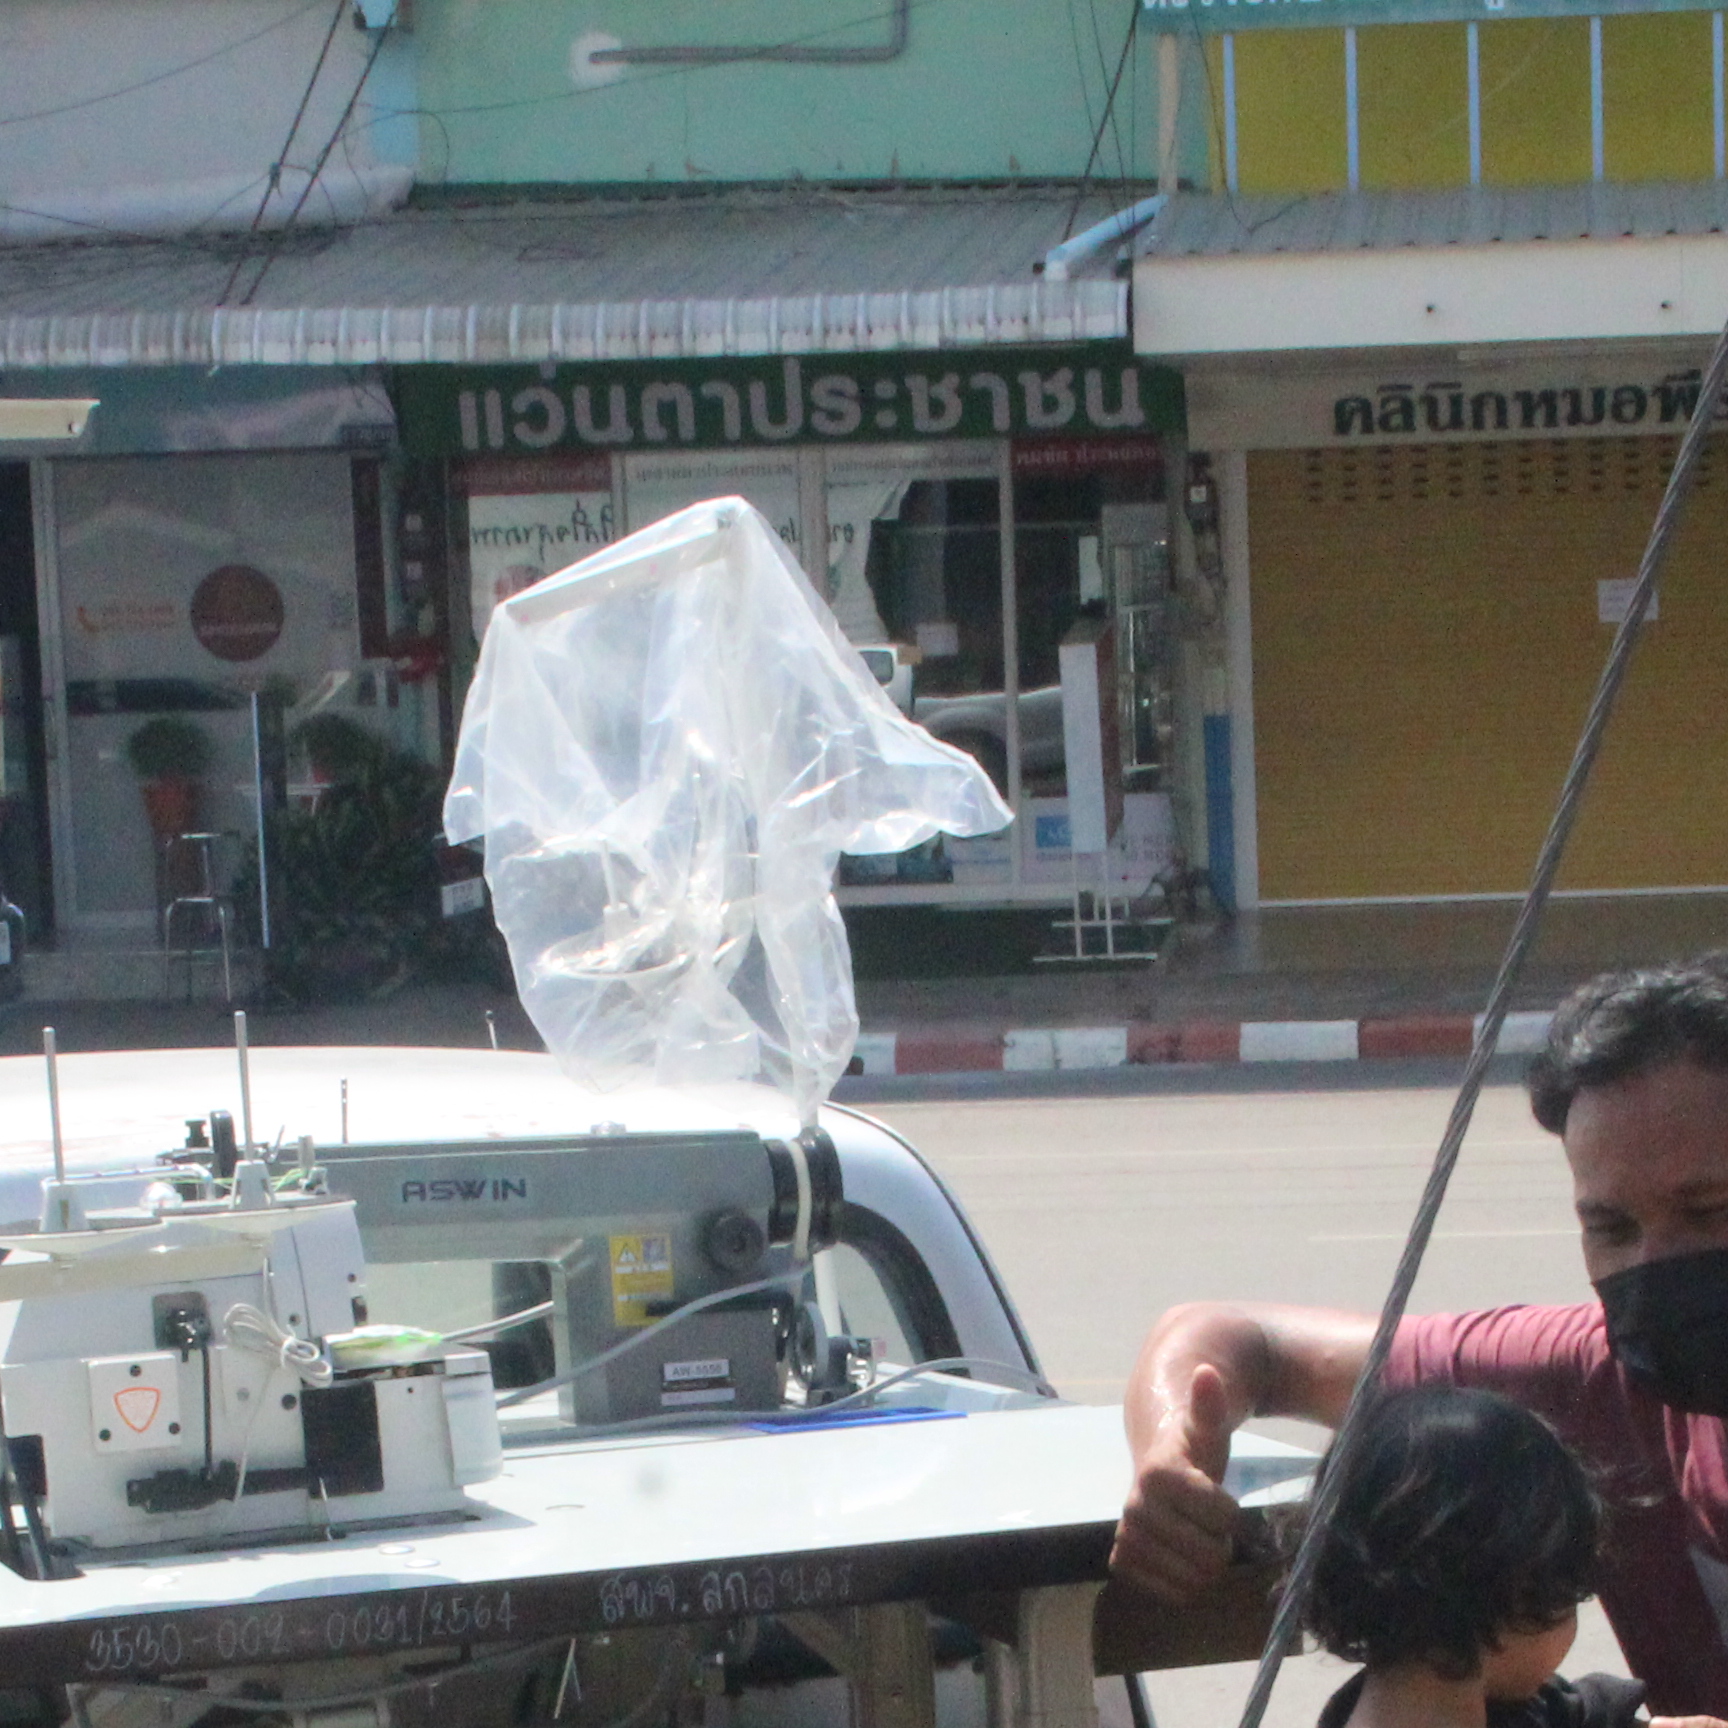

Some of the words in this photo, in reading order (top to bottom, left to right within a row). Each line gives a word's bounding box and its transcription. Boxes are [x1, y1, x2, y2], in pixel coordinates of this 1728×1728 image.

[458, 356, 1149, 449] แว่นตาประชาชน
[401, 1178, 528, 1202] ASWIN
